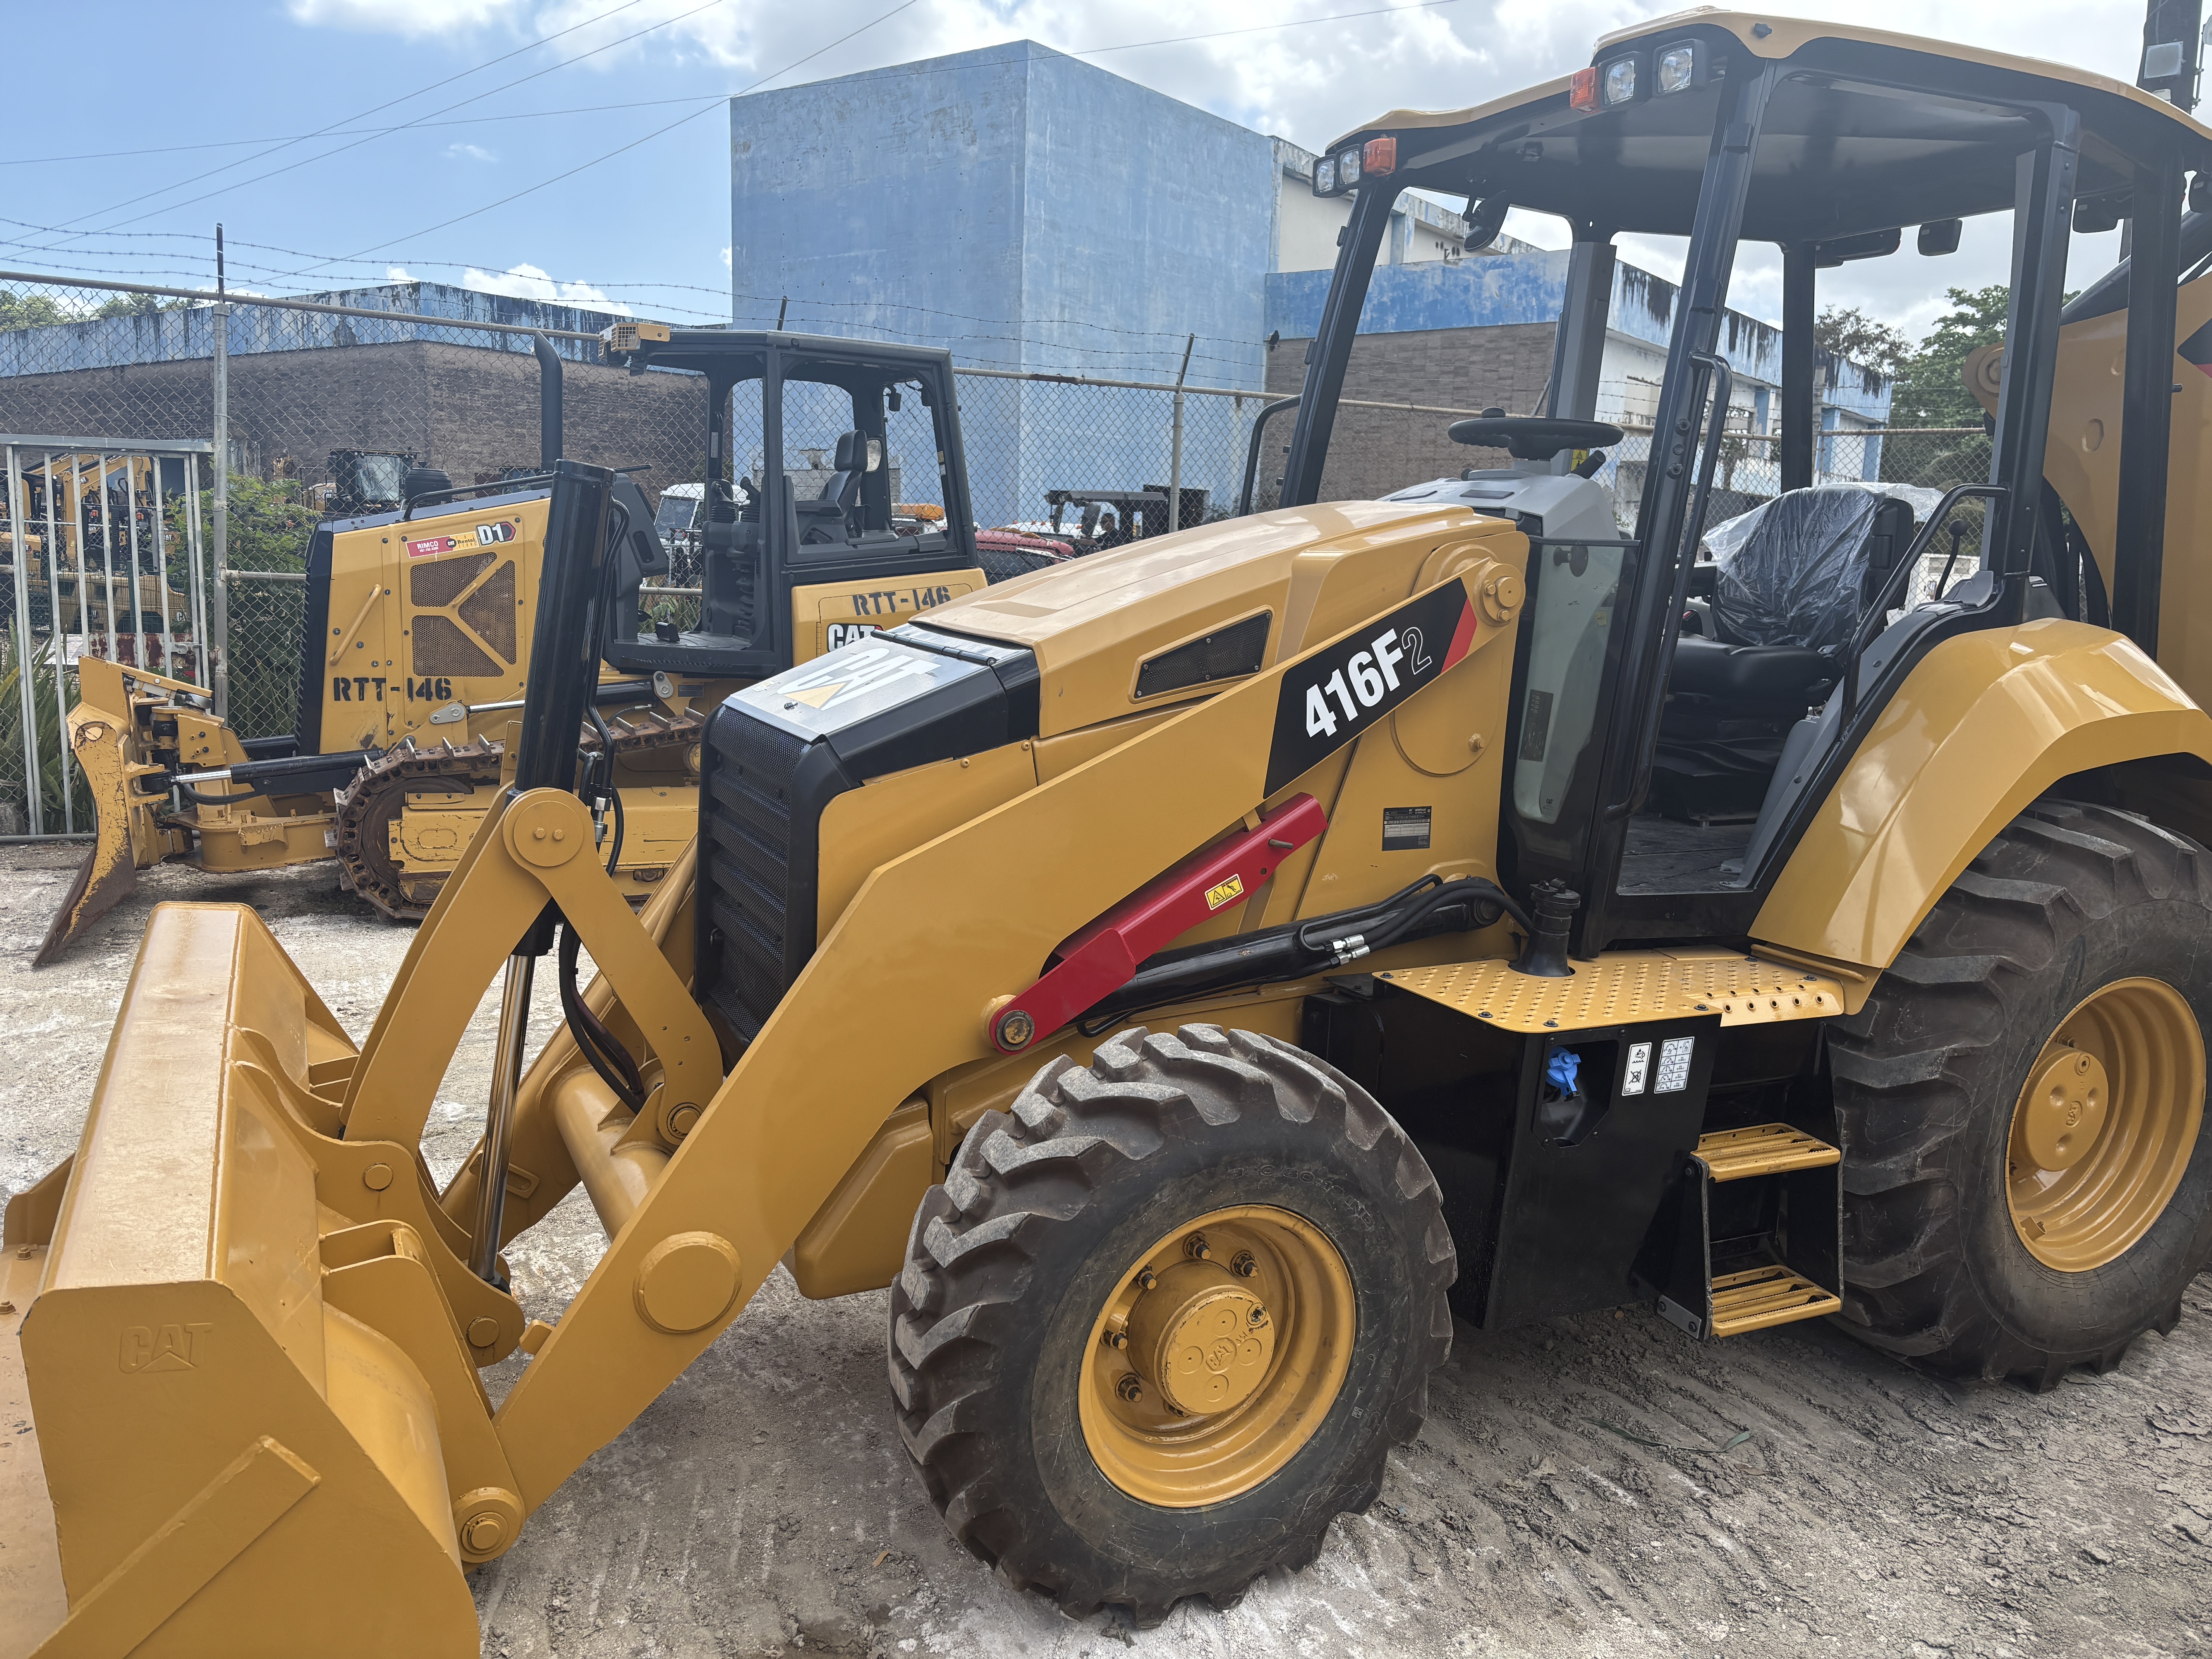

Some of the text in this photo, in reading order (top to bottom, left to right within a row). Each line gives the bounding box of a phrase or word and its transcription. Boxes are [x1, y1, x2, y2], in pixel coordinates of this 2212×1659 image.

[417, 541, 438, 550] RIMCO
[477, 523, 504, 545] D1
[853, 587, 951, 616] RTT-146
[776, 647, 942, 711] CAT
[118, 1322, 213, 1374] CAT
